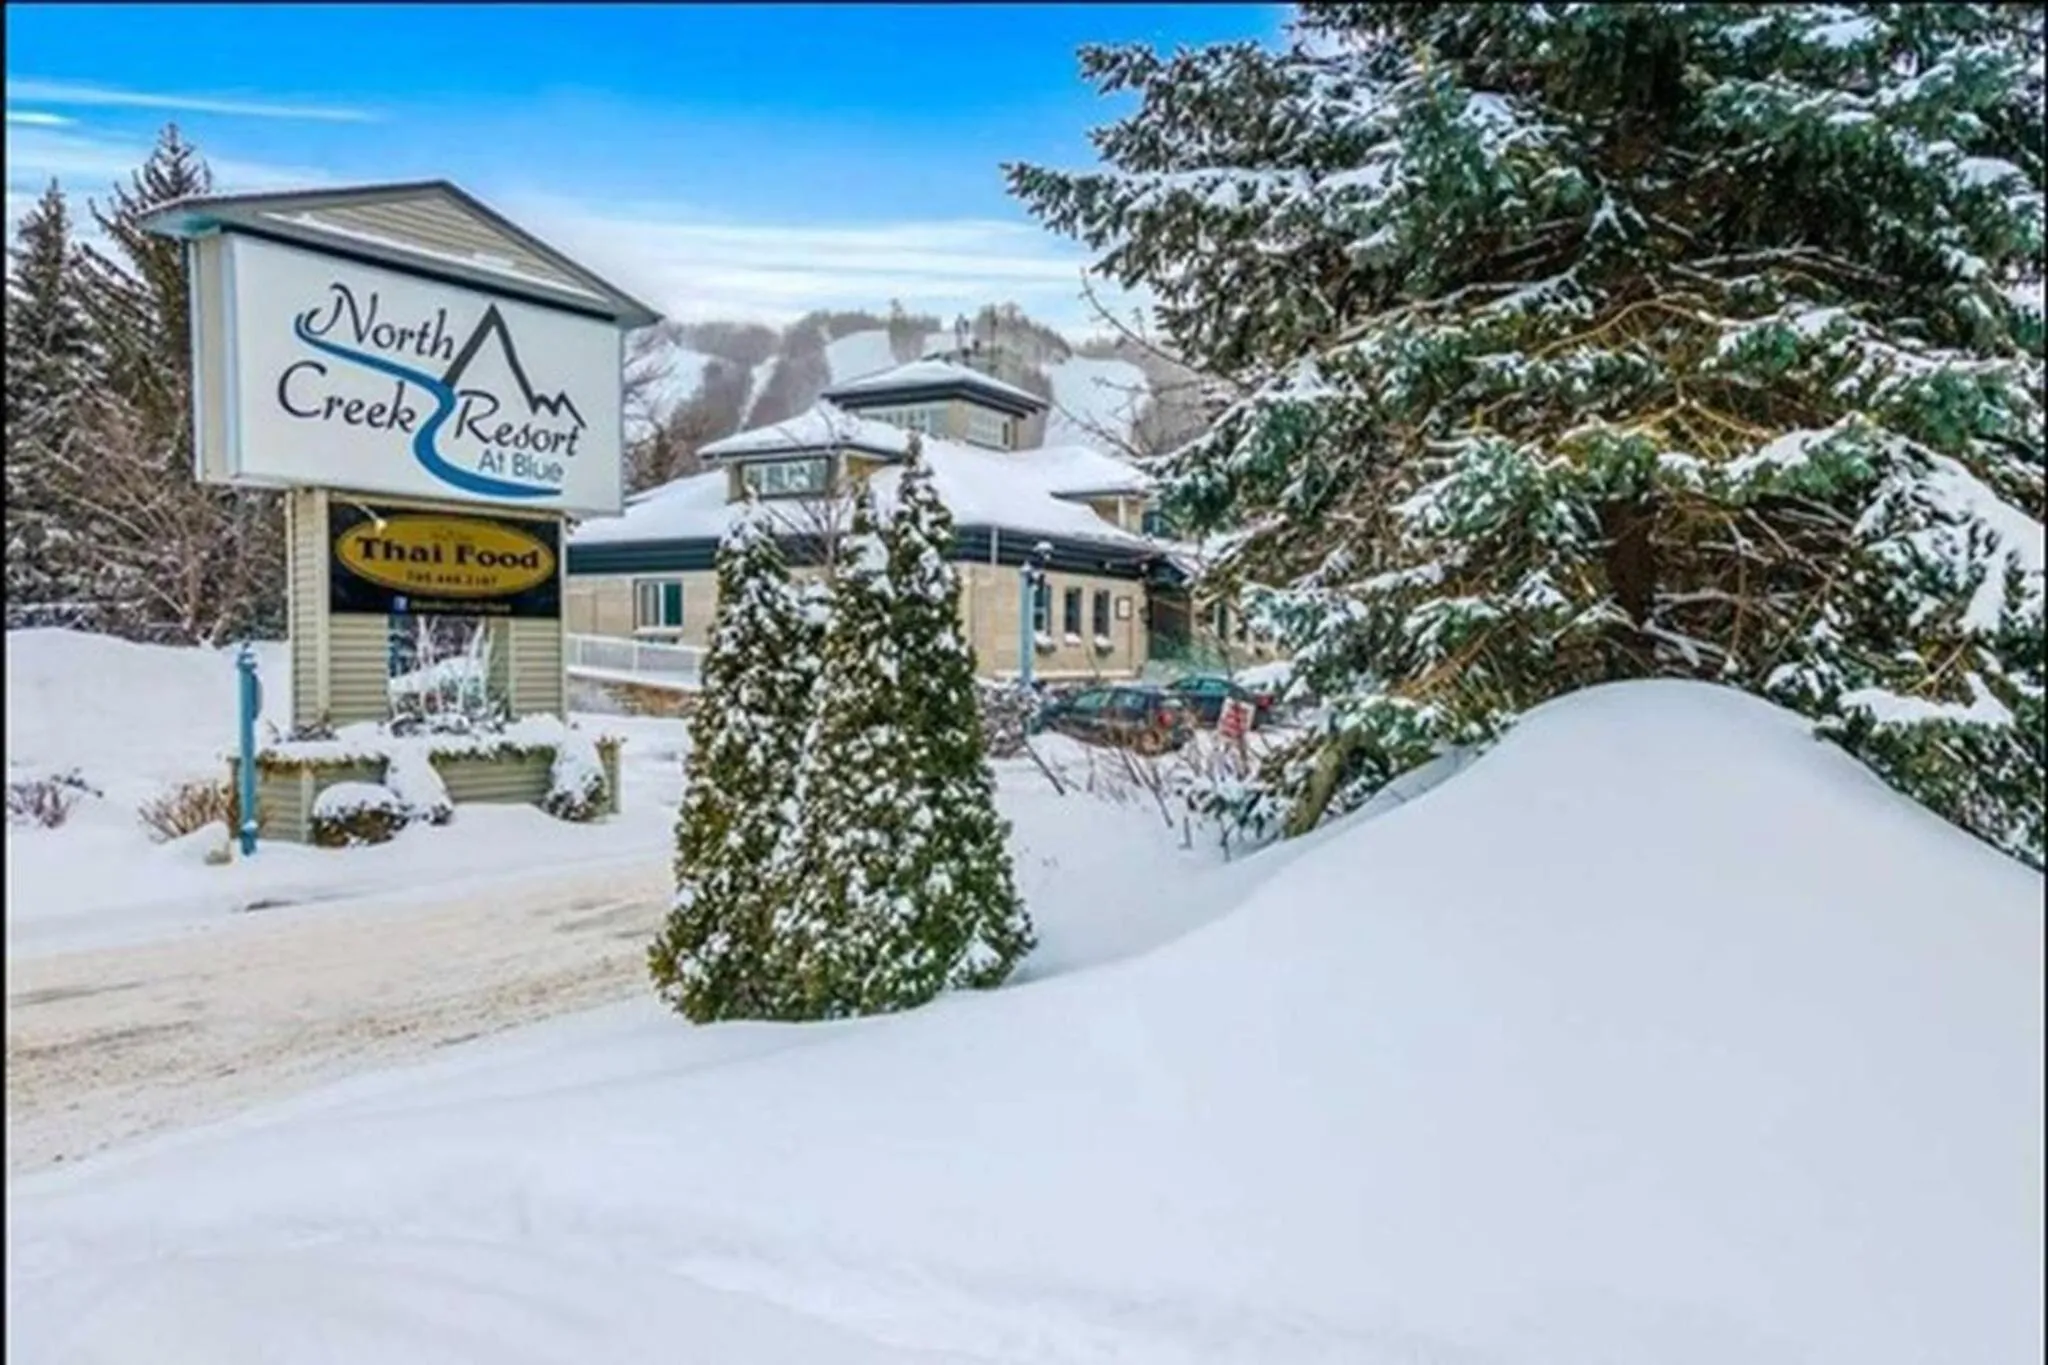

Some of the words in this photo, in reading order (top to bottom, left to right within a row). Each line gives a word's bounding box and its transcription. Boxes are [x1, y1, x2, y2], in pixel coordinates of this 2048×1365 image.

[304, 283, 455, 360] North
[278, 361, 417, 433] Creek
[454, 391, 580, 457] Resort
[478, 450, 506, 473] At
[512, 454, 565, 482] Blue
[356, 536, 443, 564] Thai
[455, 544, 540, 570] Food
